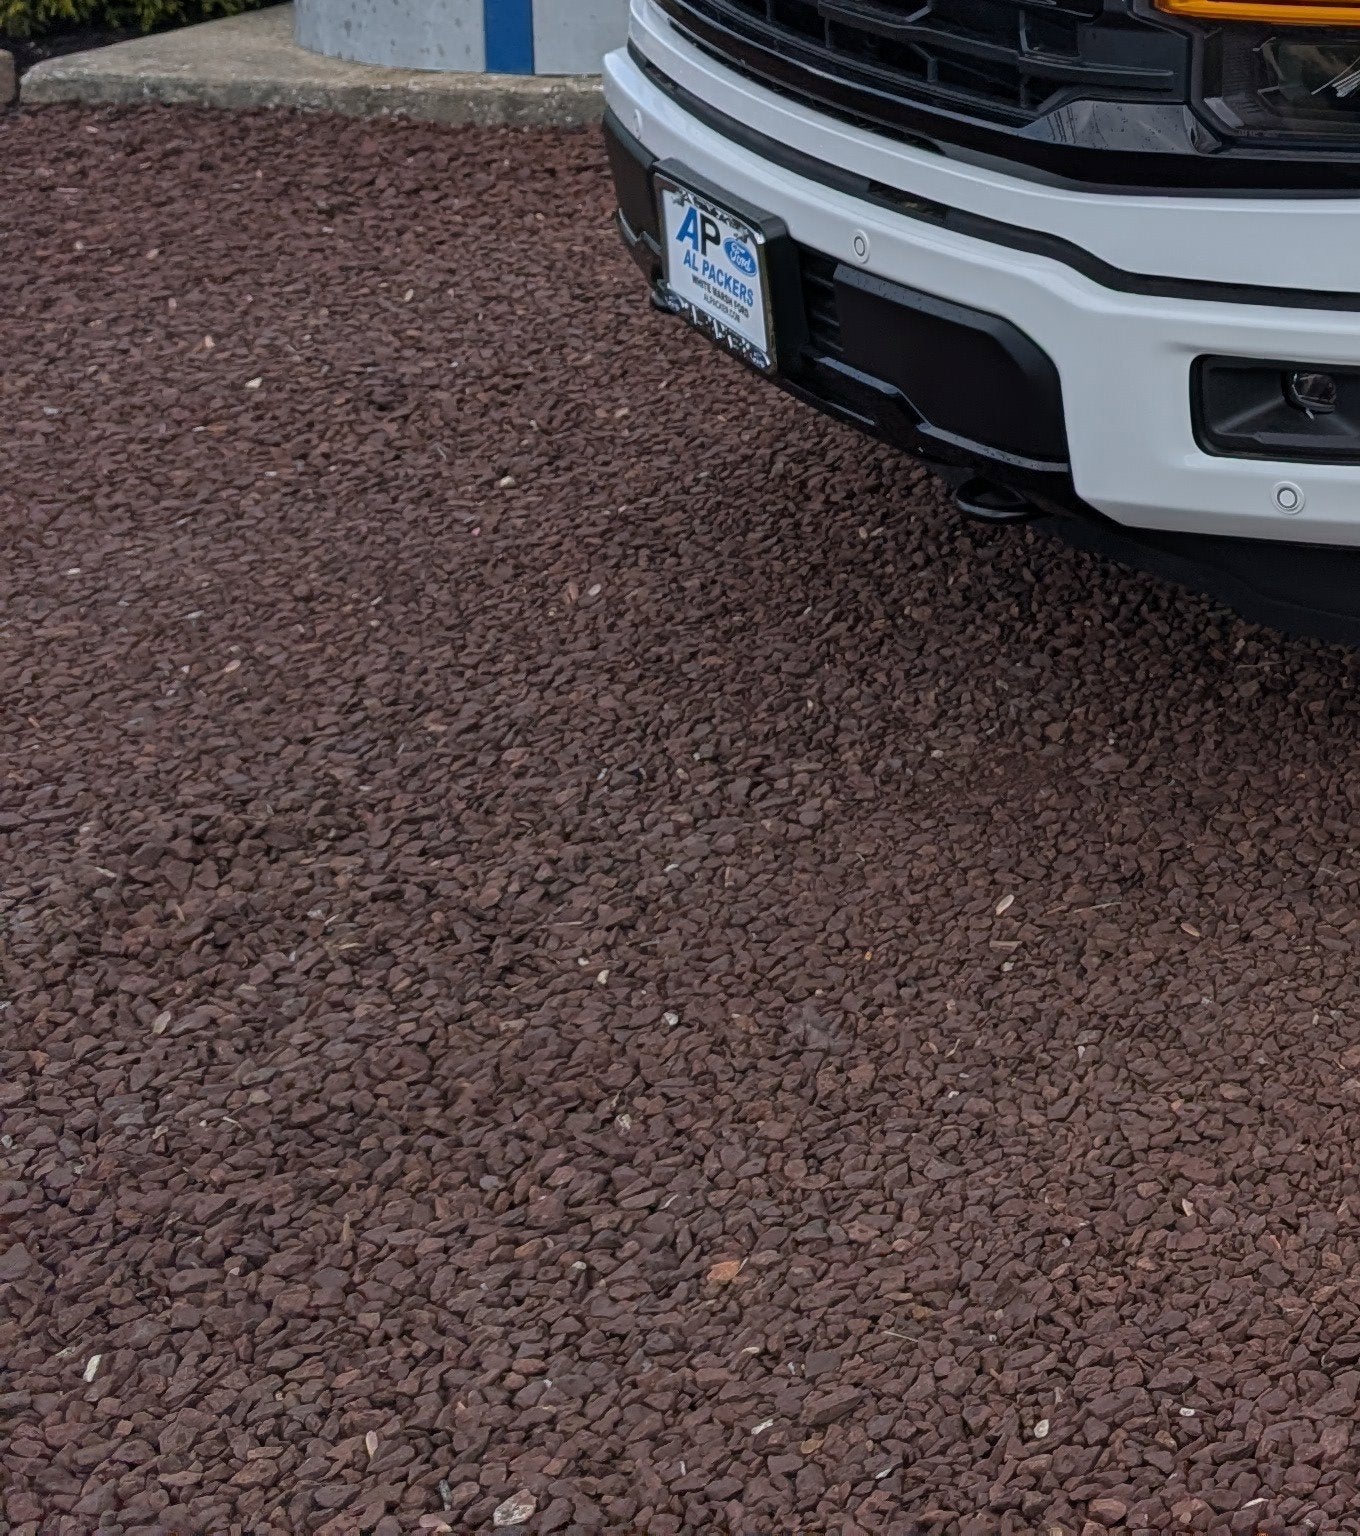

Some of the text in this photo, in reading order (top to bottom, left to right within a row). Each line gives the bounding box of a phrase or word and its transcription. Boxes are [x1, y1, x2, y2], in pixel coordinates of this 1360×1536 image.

[675, 206, 721, 256] AP
[684, 249, 754, 307] AL PACKERS
[729, 241, 752, 272] Ford
